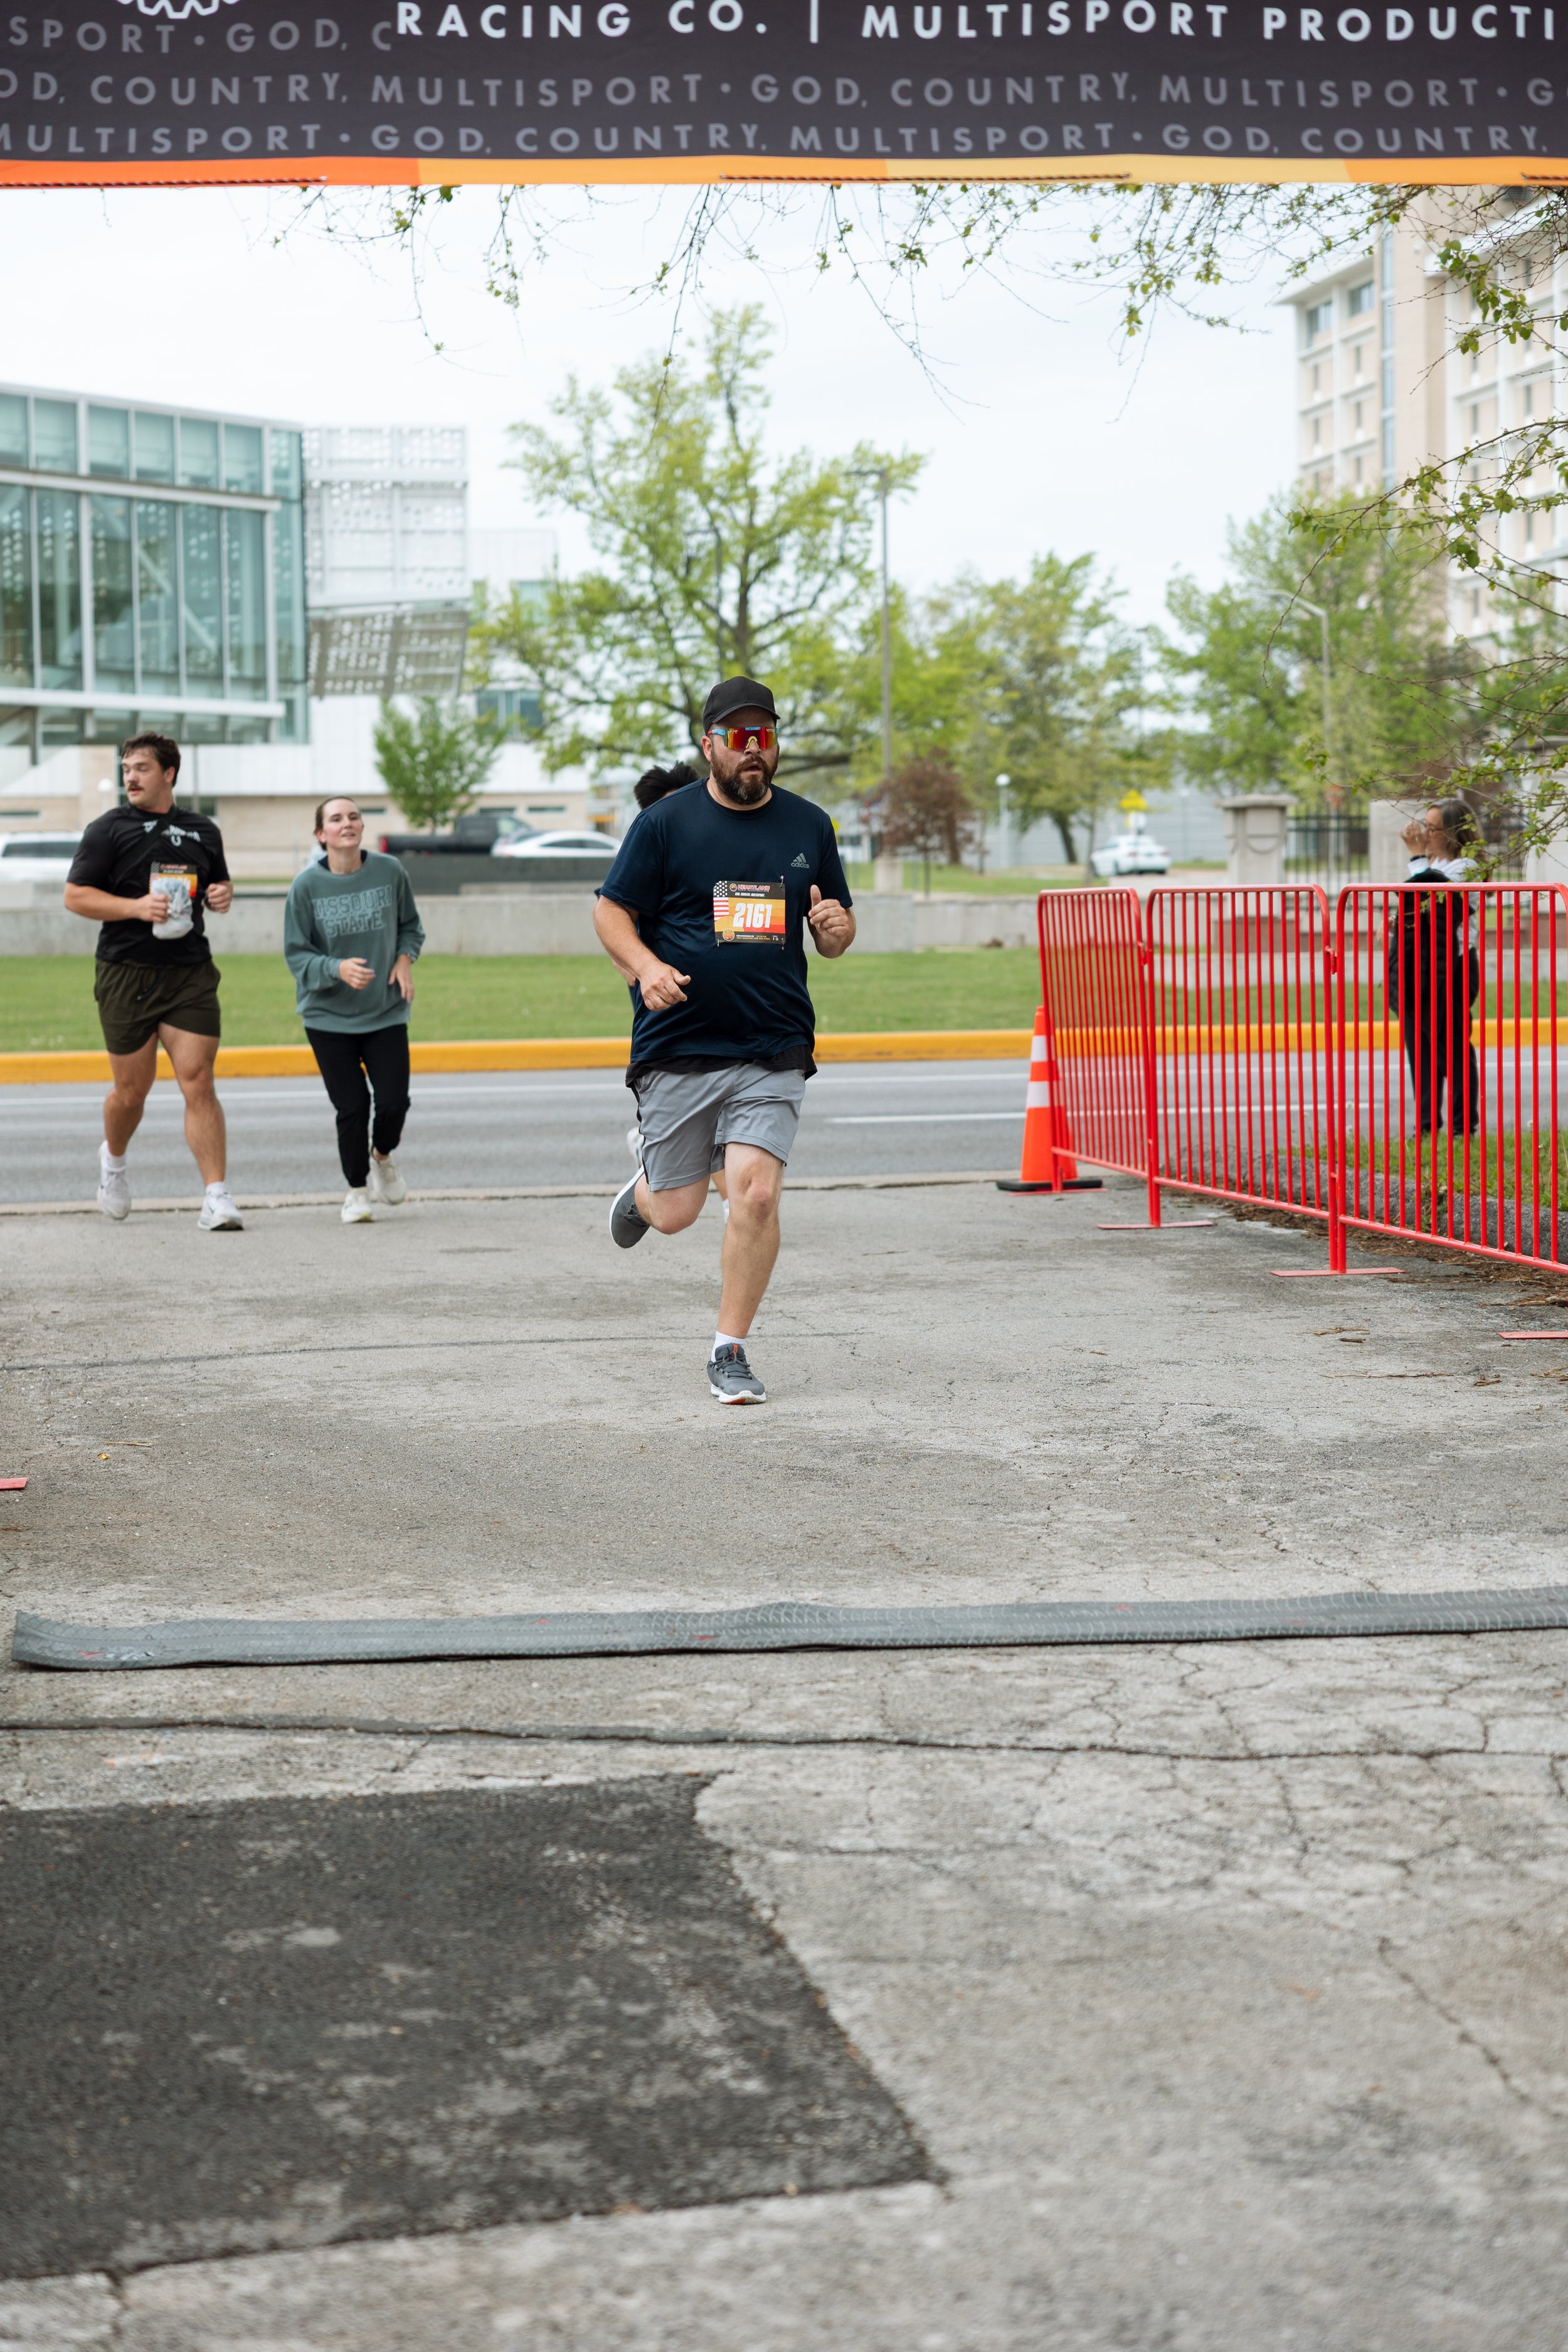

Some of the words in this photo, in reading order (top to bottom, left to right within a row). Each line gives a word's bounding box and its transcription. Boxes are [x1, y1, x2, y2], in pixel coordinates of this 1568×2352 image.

[8, 16, 175, 53] SPORT
[226, 18, 347, 53] GOD,
[397, 1, 631, 38] RACING
[668, 0, 767, 34] CO.
[861, 0, 1229, 40] MULTISPORT
[1263, 4, 1554, 42] PRODUCTI
[90, 72, 347, 106] COUNTRY,
[371, 73, 702, 107] MULTISPORT
[751, 73, 867, 109] GOD,
[891, 72, 1138, 107] COUNTRY,
[1160, 74, 1478, 108] MULTISPORT
[1527, 77, 1568, 106] G
[790, 122, 1113, 153] MULTISPORT
[323, 908, 386, 939] STATE
[733, 903, 773, 928] 2161
